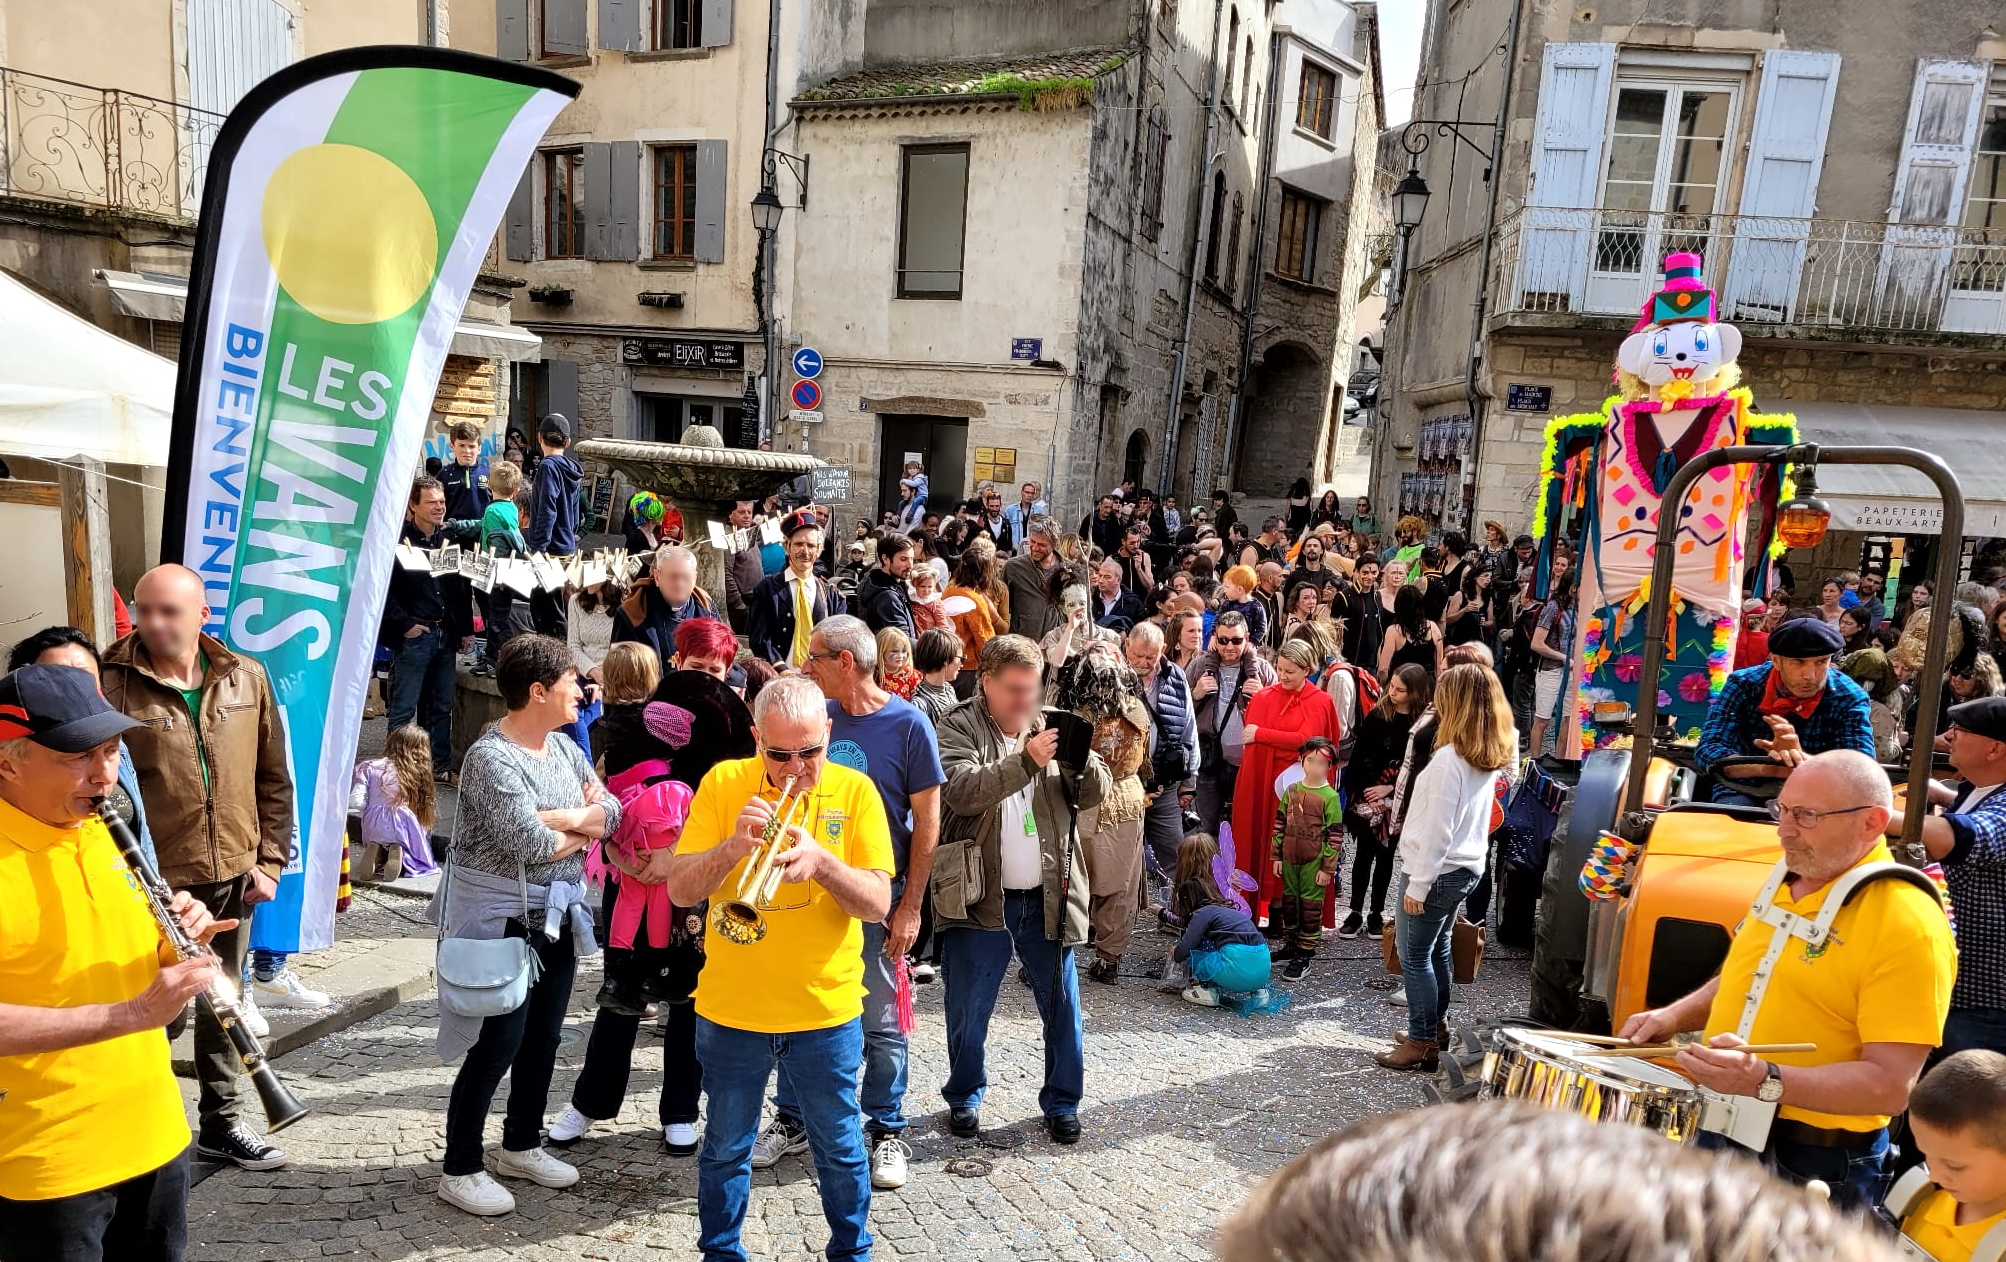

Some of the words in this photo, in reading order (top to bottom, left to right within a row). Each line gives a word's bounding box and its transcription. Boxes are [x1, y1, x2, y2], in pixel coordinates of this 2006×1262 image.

[277, 342, 393, 421] LES
[1856, 516, 1943, 528] BEAUX-ART
[1864, 506, 1943, 518] PAPETERIE
[230, 420, 378, 661] VANS
